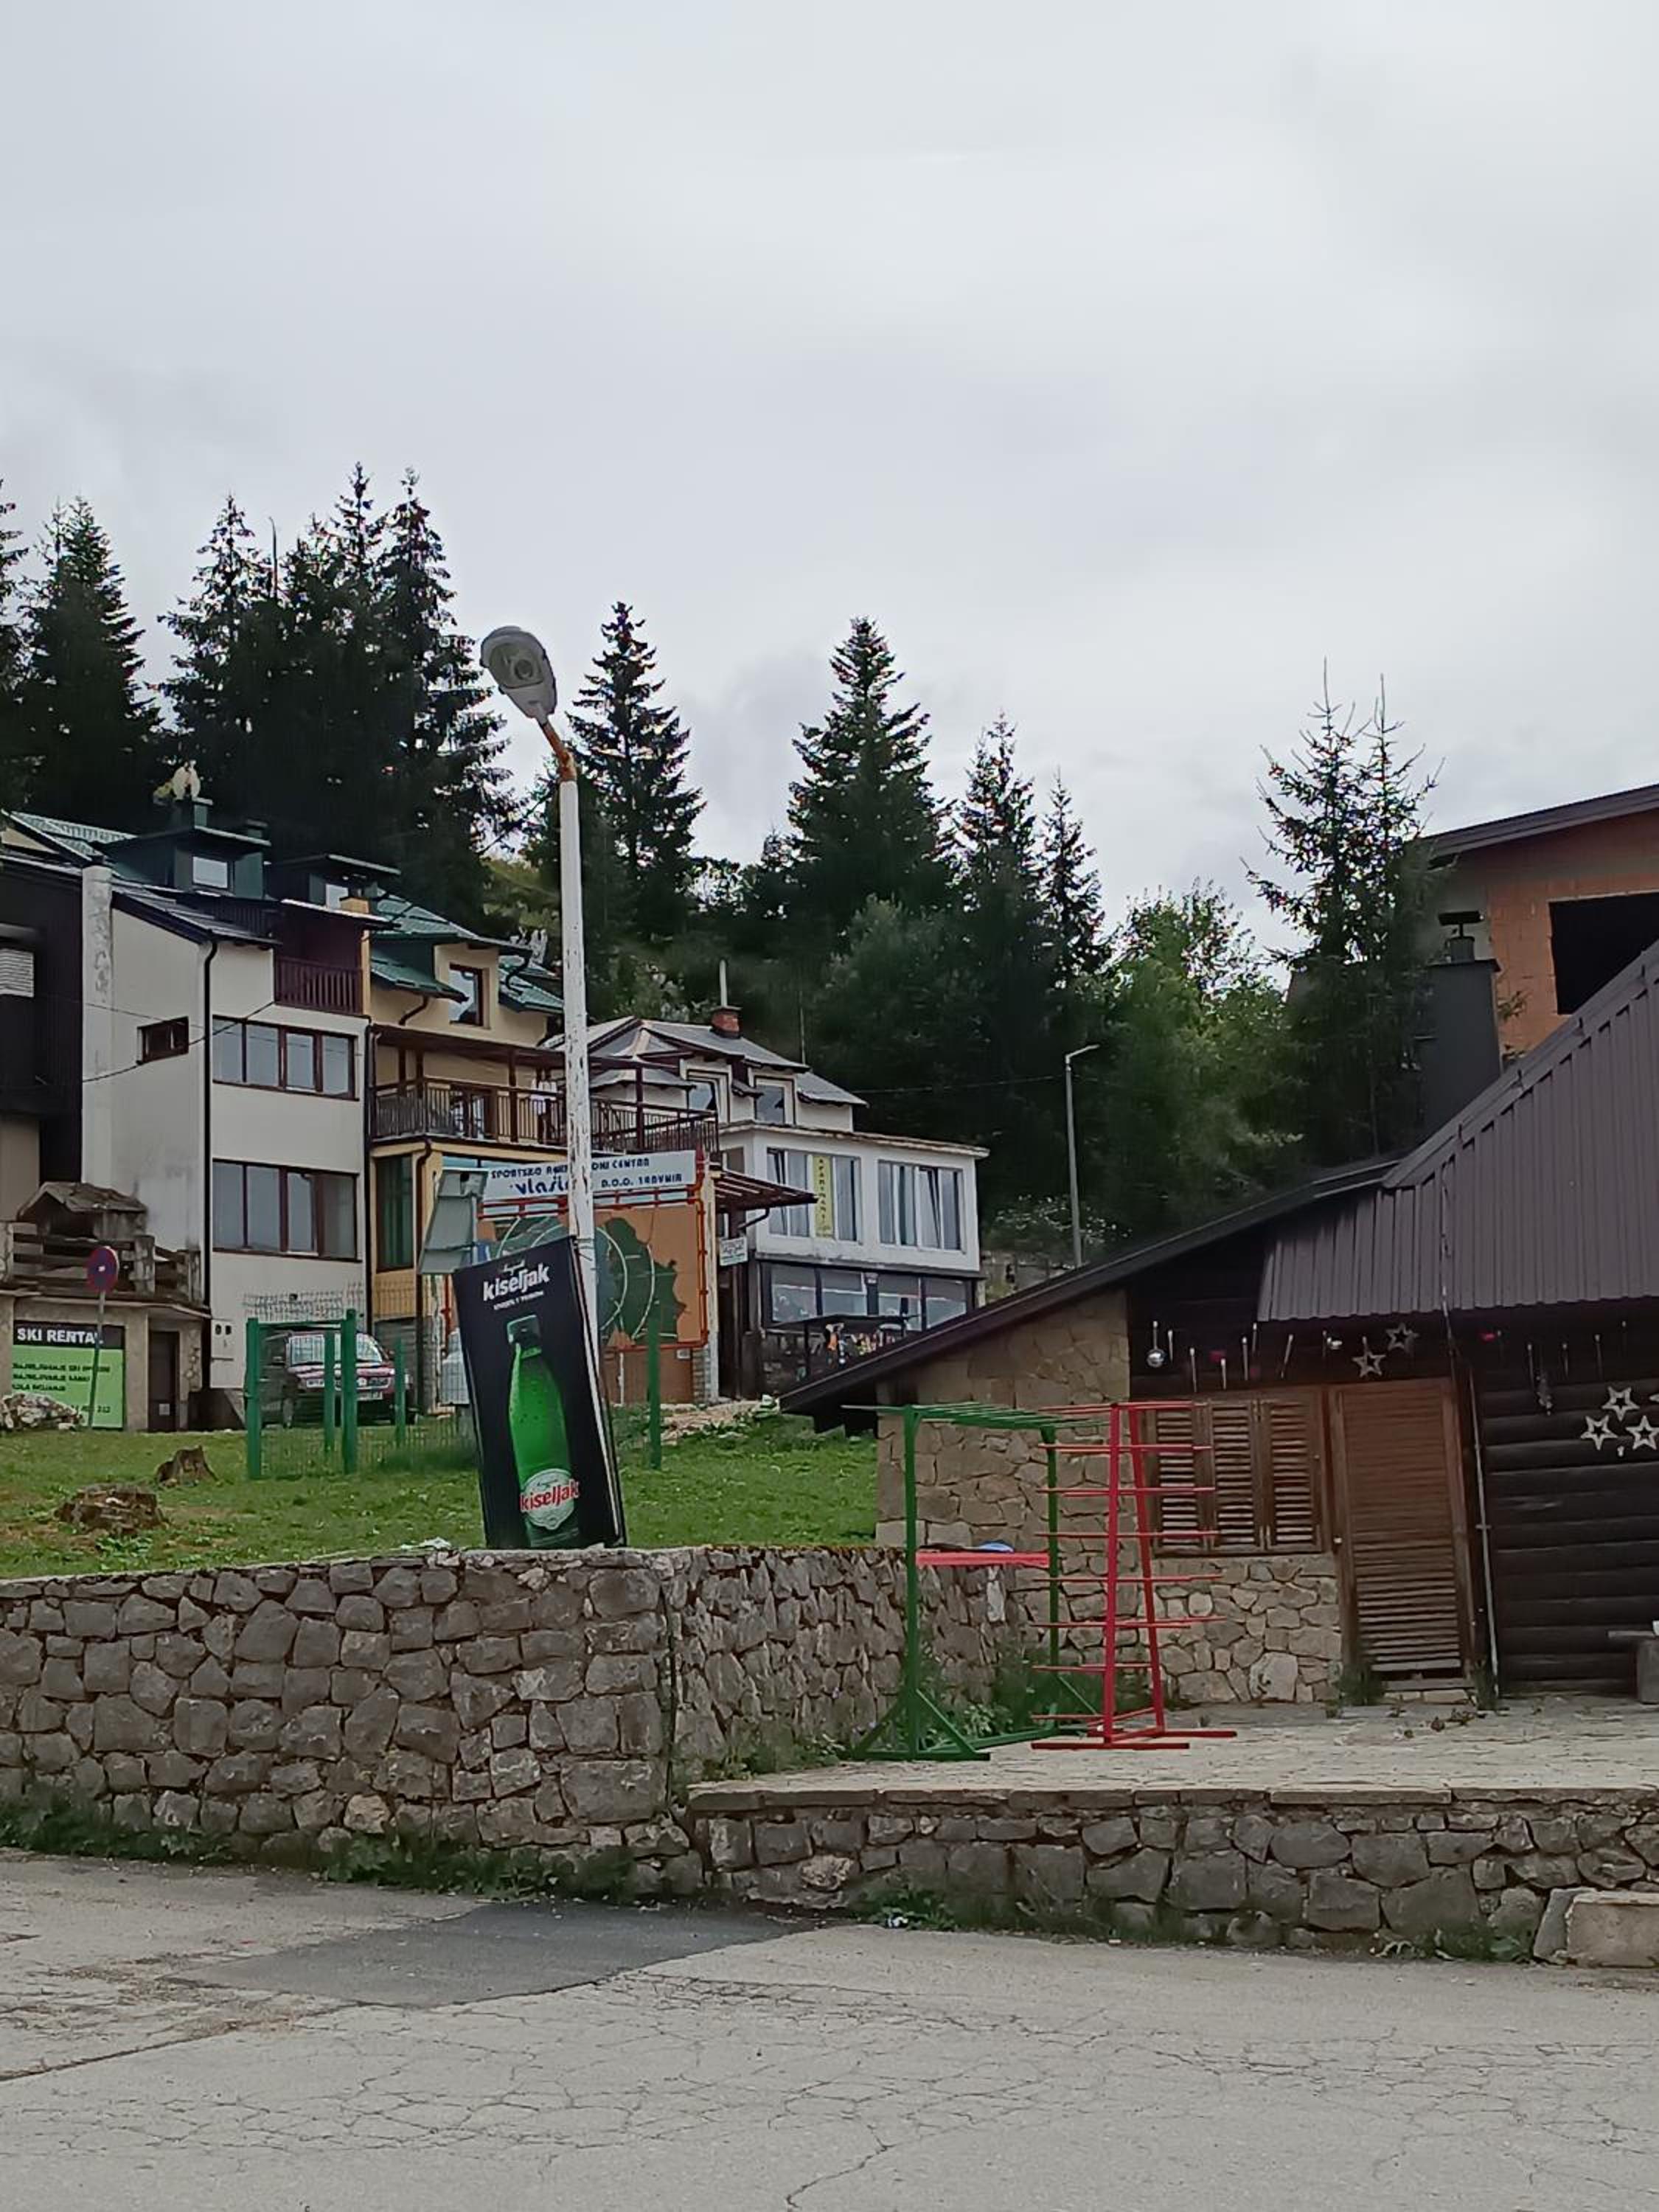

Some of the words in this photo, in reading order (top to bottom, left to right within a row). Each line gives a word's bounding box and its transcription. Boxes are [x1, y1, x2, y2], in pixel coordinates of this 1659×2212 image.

[483, 1262, 550, 1301] kiseljak
[17, 1328, 43, 1341] SKI
[519, 1479, 580, 1512] kiseljak
